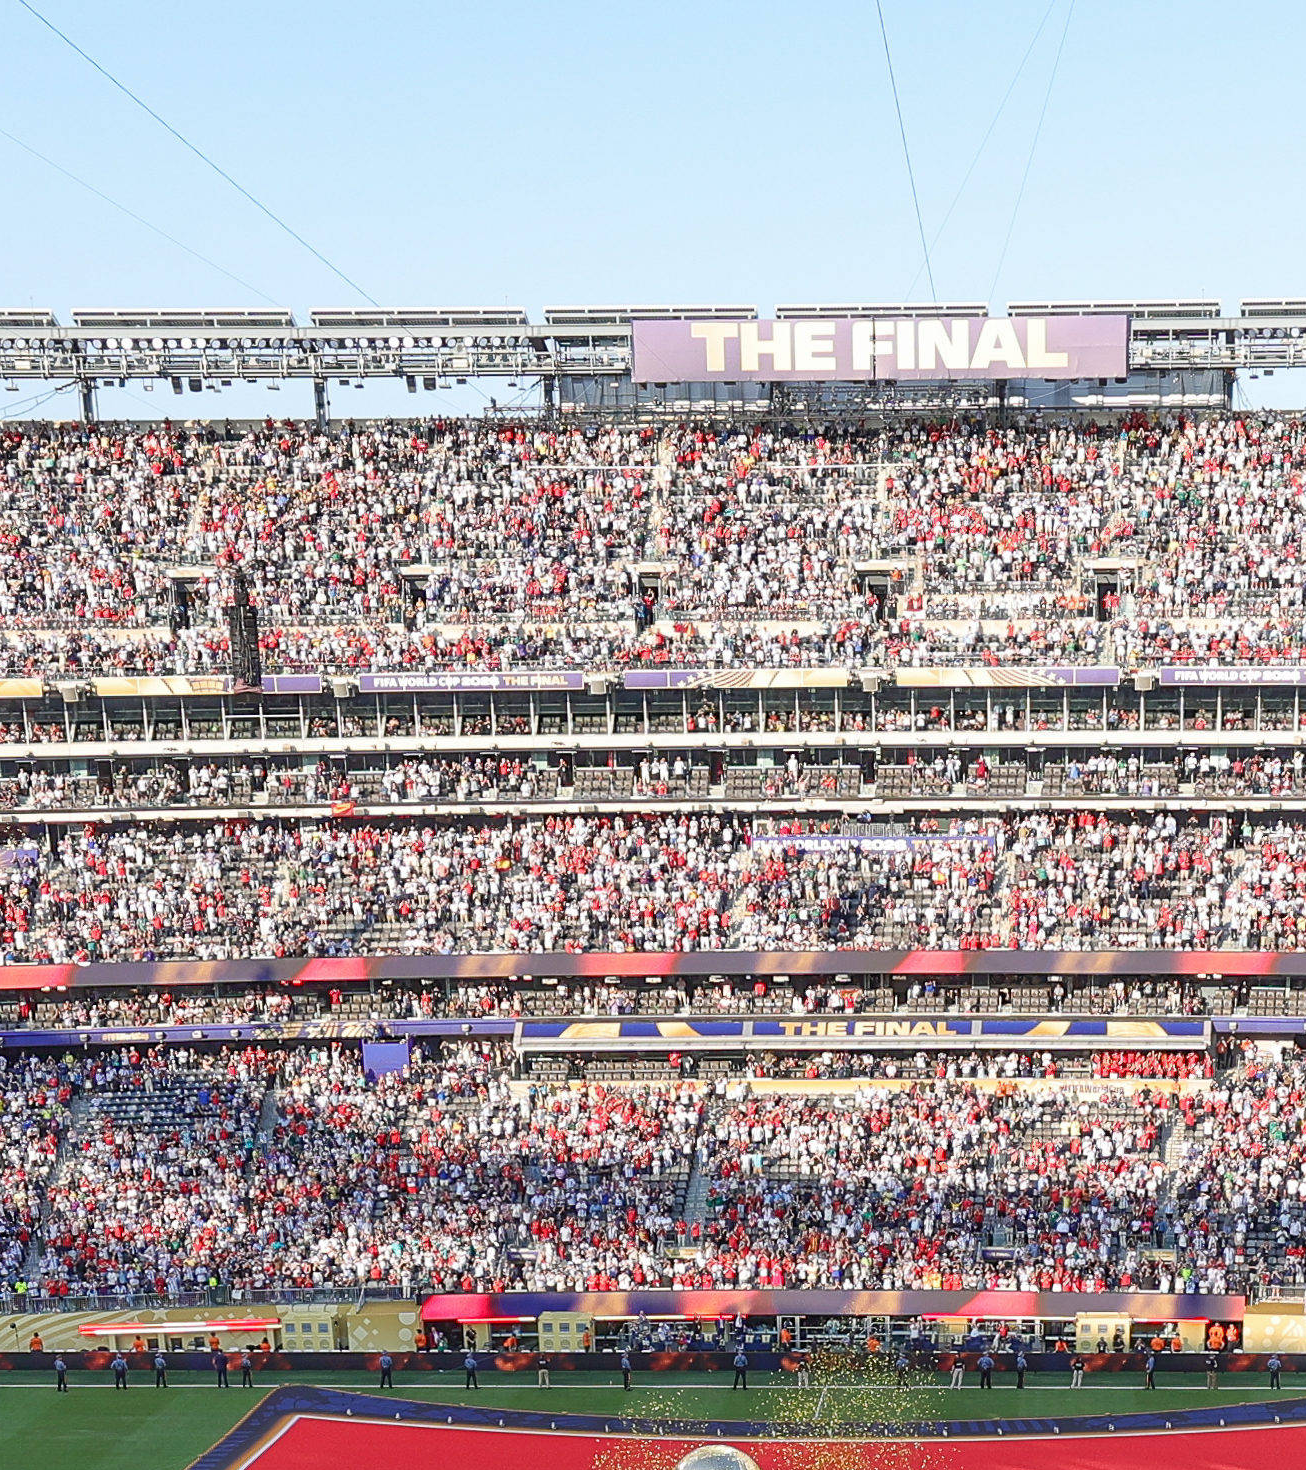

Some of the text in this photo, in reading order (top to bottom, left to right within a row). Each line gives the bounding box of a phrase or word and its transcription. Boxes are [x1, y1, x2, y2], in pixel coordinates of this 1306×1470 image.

[691, 317, 1069, 371] THE FINAL
[373, 676, 396, 687] FIFA
[398, 676, 437, 687] WORLD
[439, 676, 460, 687] CUP
[503, 676, 529, 686] THE
[530, 676, 568, 686] FINAL
[1174, 671, 1198, 681] FIFA
[1199, 671, 1238, 681] WORLD
[1239, 671, 1261, 681] CUP
[779, 1021, 957, 1035] THE FINAL
